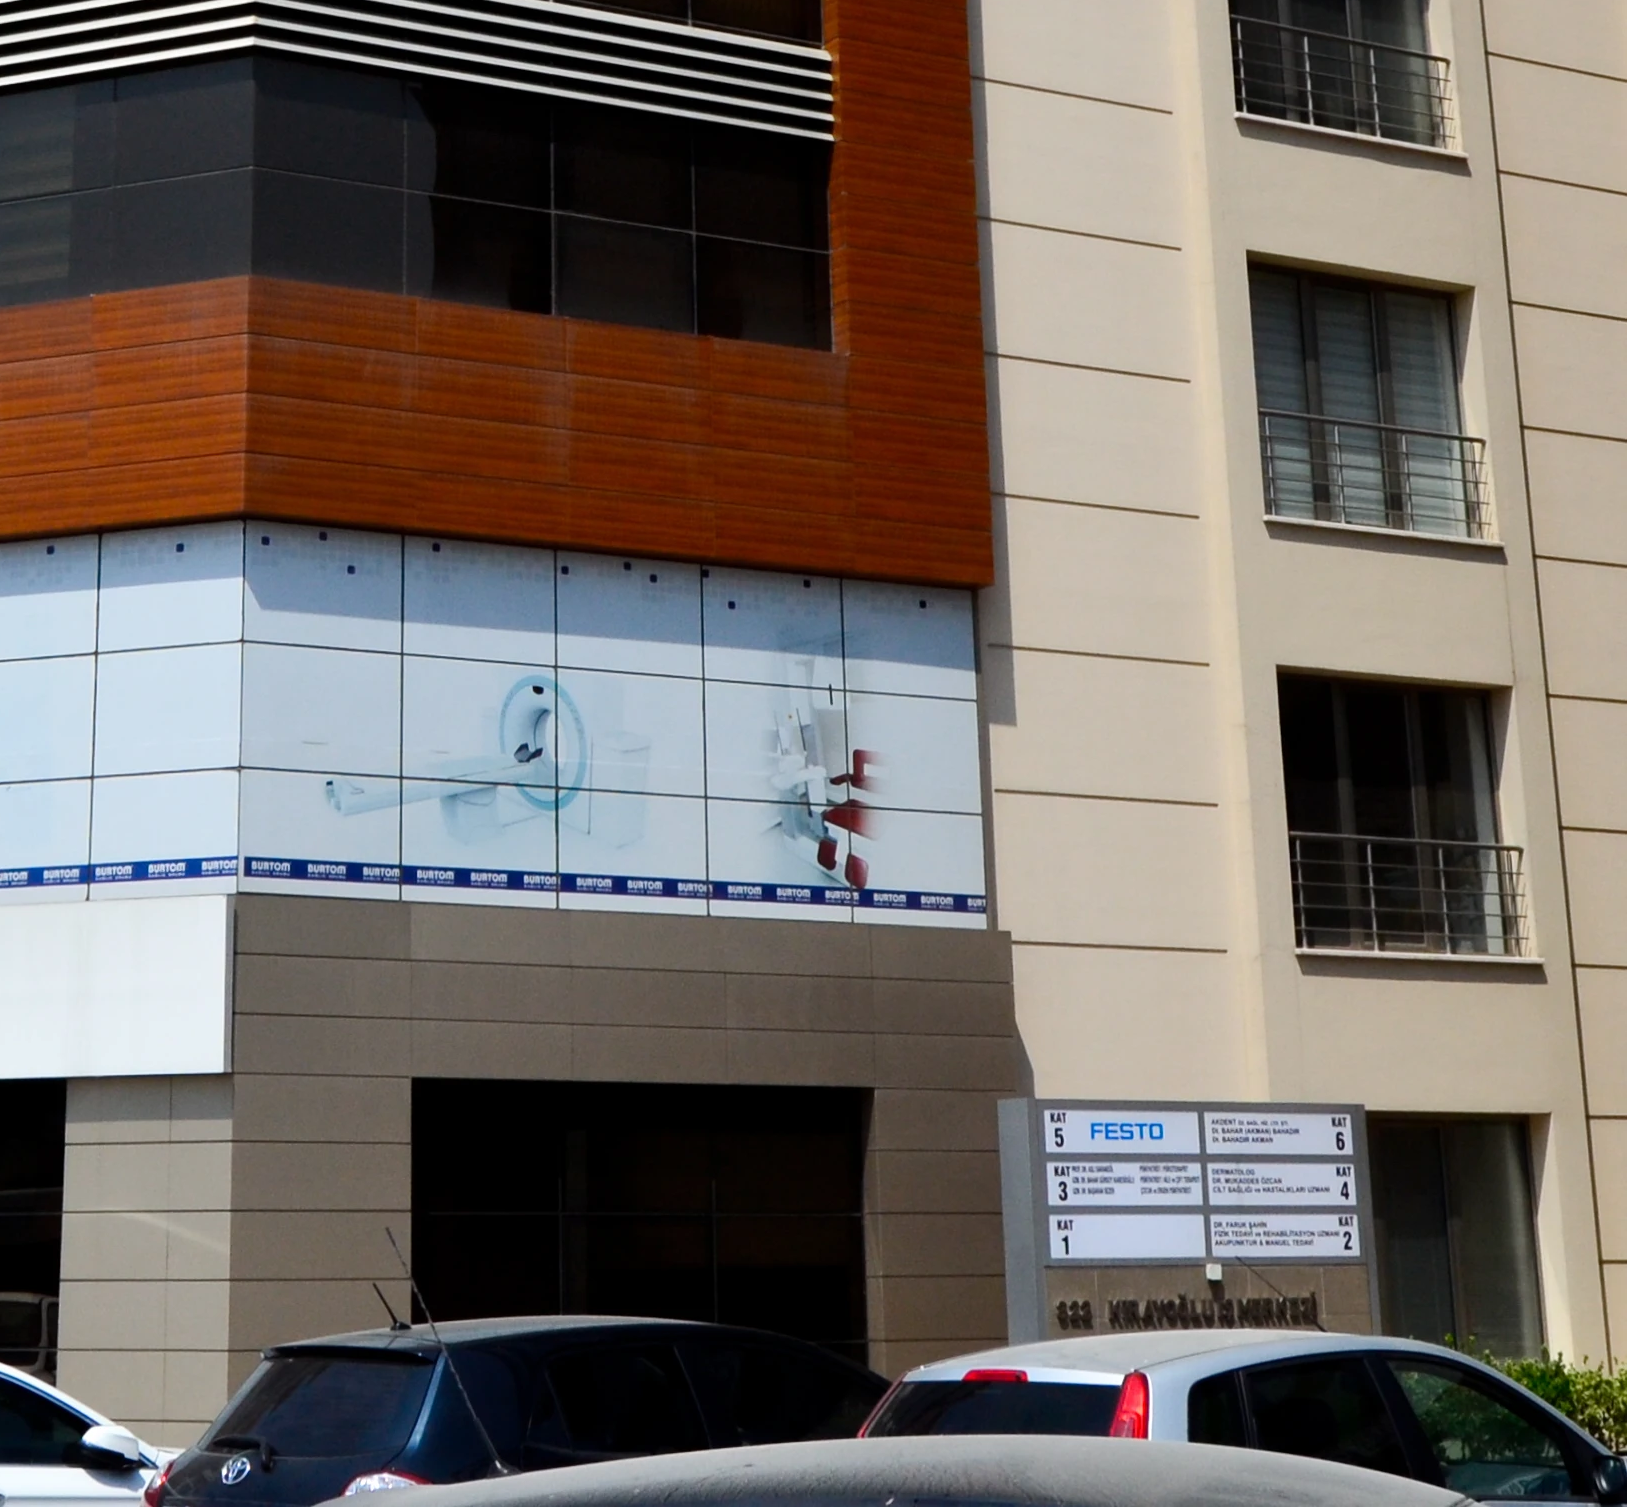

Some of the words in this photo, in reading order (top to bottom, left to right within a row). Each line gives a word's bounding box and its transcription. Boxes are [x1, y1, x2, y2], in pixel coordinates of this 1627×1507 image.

[1050, 1112, 1067, 1124] KAT
[1331, 1117, 1347, 1128] KAT
[1054, 1128, 1065, 1148] 5
[1090, 1122, 1164, 1141] FESTO
[1335, 1131, 1346, 1151] 6
[1054, 1165, 1071, 1177] KAT
[1335, 1166, 1352, 1178] KAT
[1058, 1181, 1068, 1201] 3
[1340, 1181, 1350, 1201] 4
[1057, 1219, 1074, 1231] KAT
[1338, 1216, 1354, 1228] KAT
[1061, 1236, 1069, 1255] 1
[1343, 1231, 1353, 1251] 2
